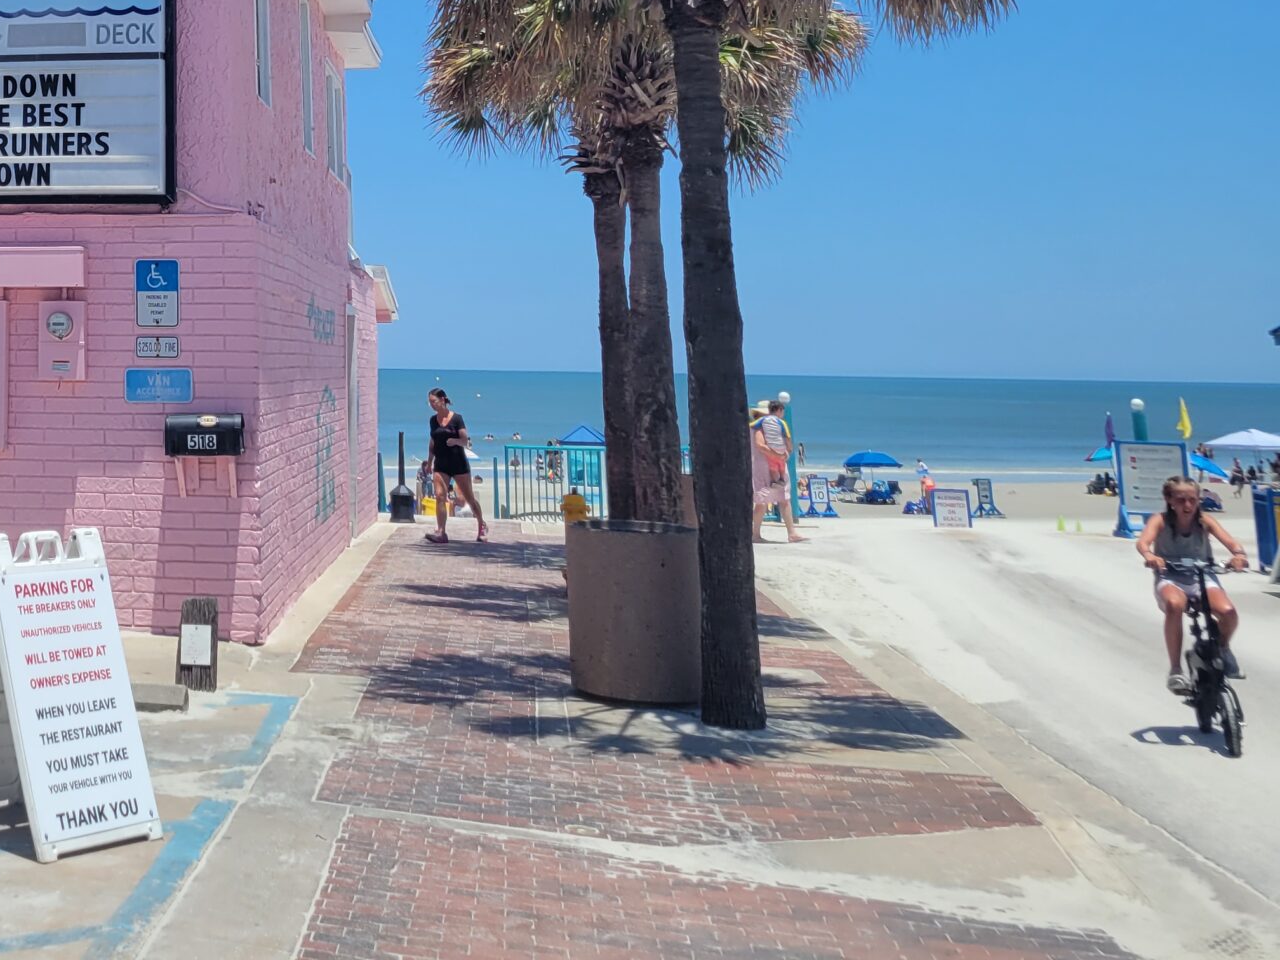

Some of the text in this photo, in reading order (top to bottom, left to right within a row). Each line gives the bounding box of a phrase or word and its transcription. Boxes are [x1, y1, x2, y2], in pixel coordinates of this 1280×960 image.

[95, 22, 156, 45] DECK
[2, 73, 77, 98] DOWN
[21, 102, 86, 127] BEST
[164, 342, 177, 353] FINE
[147, 375, 171, 387] VAN
[187, 434, 217, 450] 518
[813, 491, 824, 500] 10
[14, 578, 95, 599] PARKING FOR
[17, 598, 96, 616] THE BREAKERS ONLY
[20, 621, 103, 639] UNAUTHORIZED VEHICLES
[25, 644, 107, 666] WILL BE TOWED AT
[29, 668, 112, 690] OWNER'S EXPENSE
[35, 697, 117, 720] WHEN YOU LEAVE
[39, 721, 123, 746] THE RESTAURANT
[45, 747, 129, 774] YOU MUST TAKE
[48, 769, 133, 795] YOUR VEHICLE WITH YOU
[55, 797, 139, 831] THANK YOU
